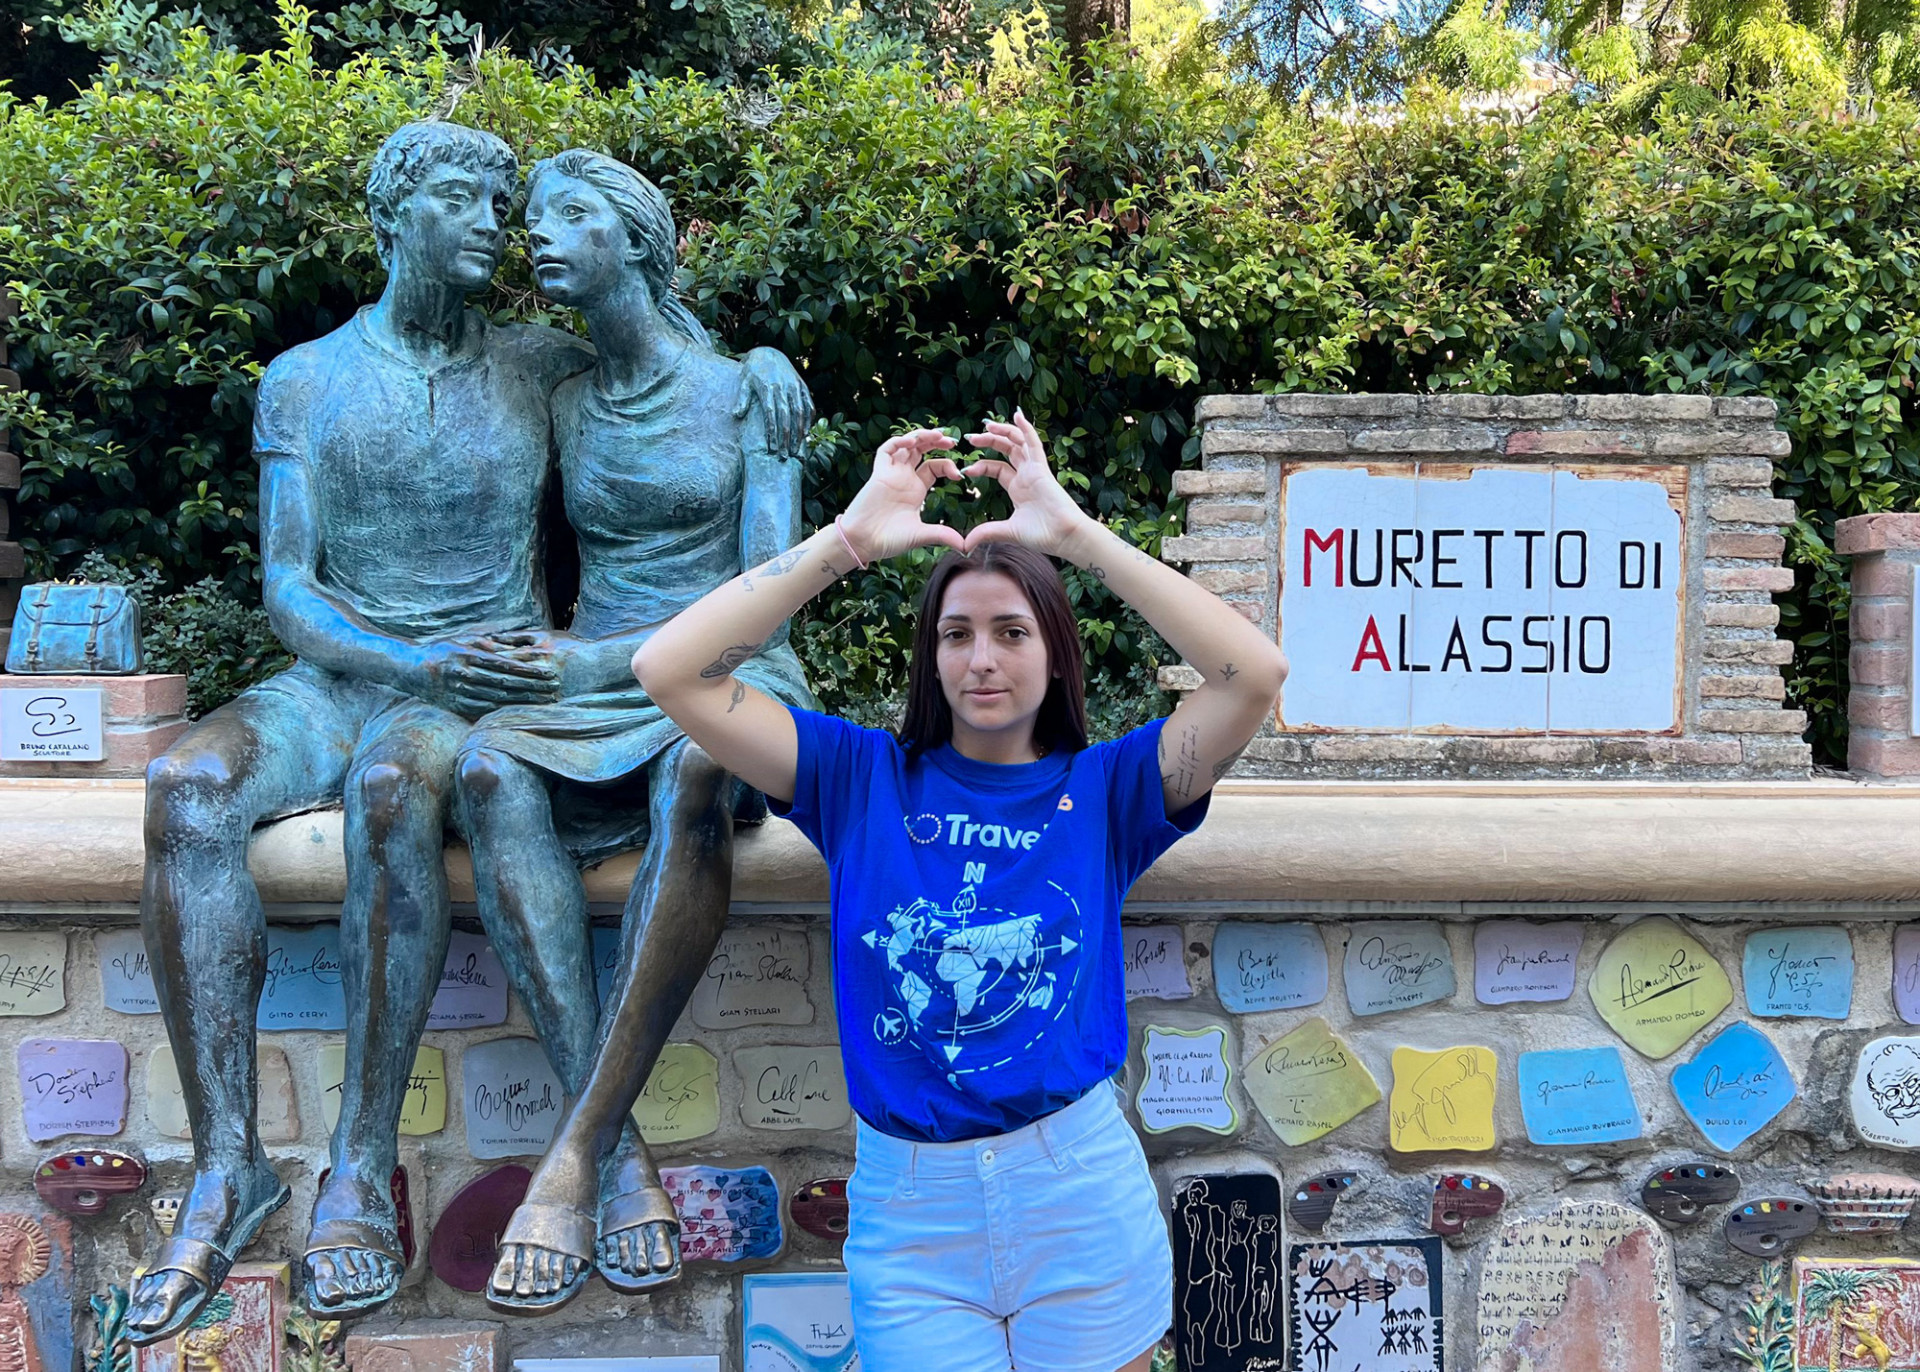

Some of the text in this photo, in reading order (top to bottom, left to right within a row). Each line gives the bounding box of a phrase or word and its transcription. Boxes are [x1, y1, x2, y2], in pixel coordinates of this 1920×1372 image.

[1302, 528, 1663, 590] MURETTO DI
[1350, 613, 1612, 675] ALASSIO
[20, 743, 90, 751] BRUNO CATALANO
[945, 813, 1050, 851] Trave
[962, 861, 987, 884] N
[743, 1007, 781, 1017] STELLARI
[1635, 1009, 1706, 1026] ARMANDO ROMEO
[1156, 1107, 1214, 1116] GIORNALISTA
[1705, 1118, 1730, 1126] DUILIO
[1860, 1125, 1909, 1145] GILBERTO GOVI
